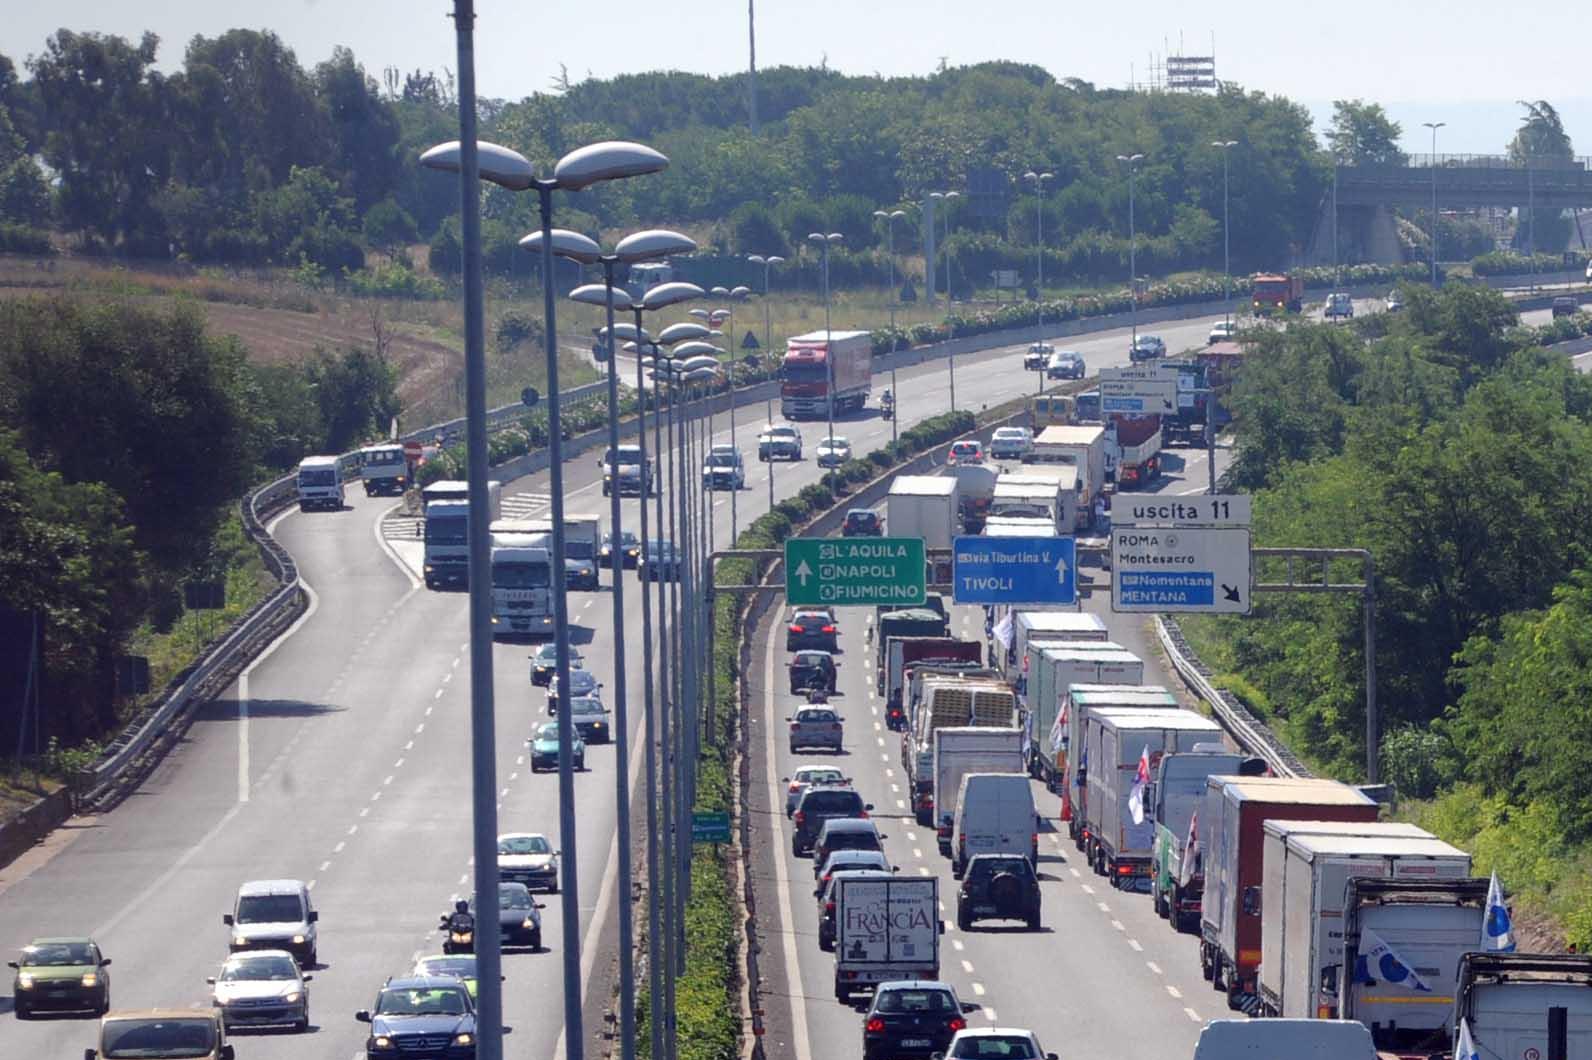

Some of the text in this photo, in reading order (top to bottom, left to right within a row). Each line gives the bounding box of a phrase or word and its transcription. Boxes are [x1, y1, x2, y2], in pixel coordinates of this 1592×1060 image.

[1133, 500, 1230, 519] uscita 11
[1119, 535, 1158, 546] ROMA
[835, 545, 907, 558] L'AQUILA
[1119, 553, 1195, 564] Montesacro
[836, 565, 896, 577] NAPOLI
[963, 577, 1013, 590] TIVOLI
[1140, 575, 1212, 586] Nomentana
[836, 585, 918, 598] FIUMICINO
[1121, 591, 1186, 602] MENTANA
